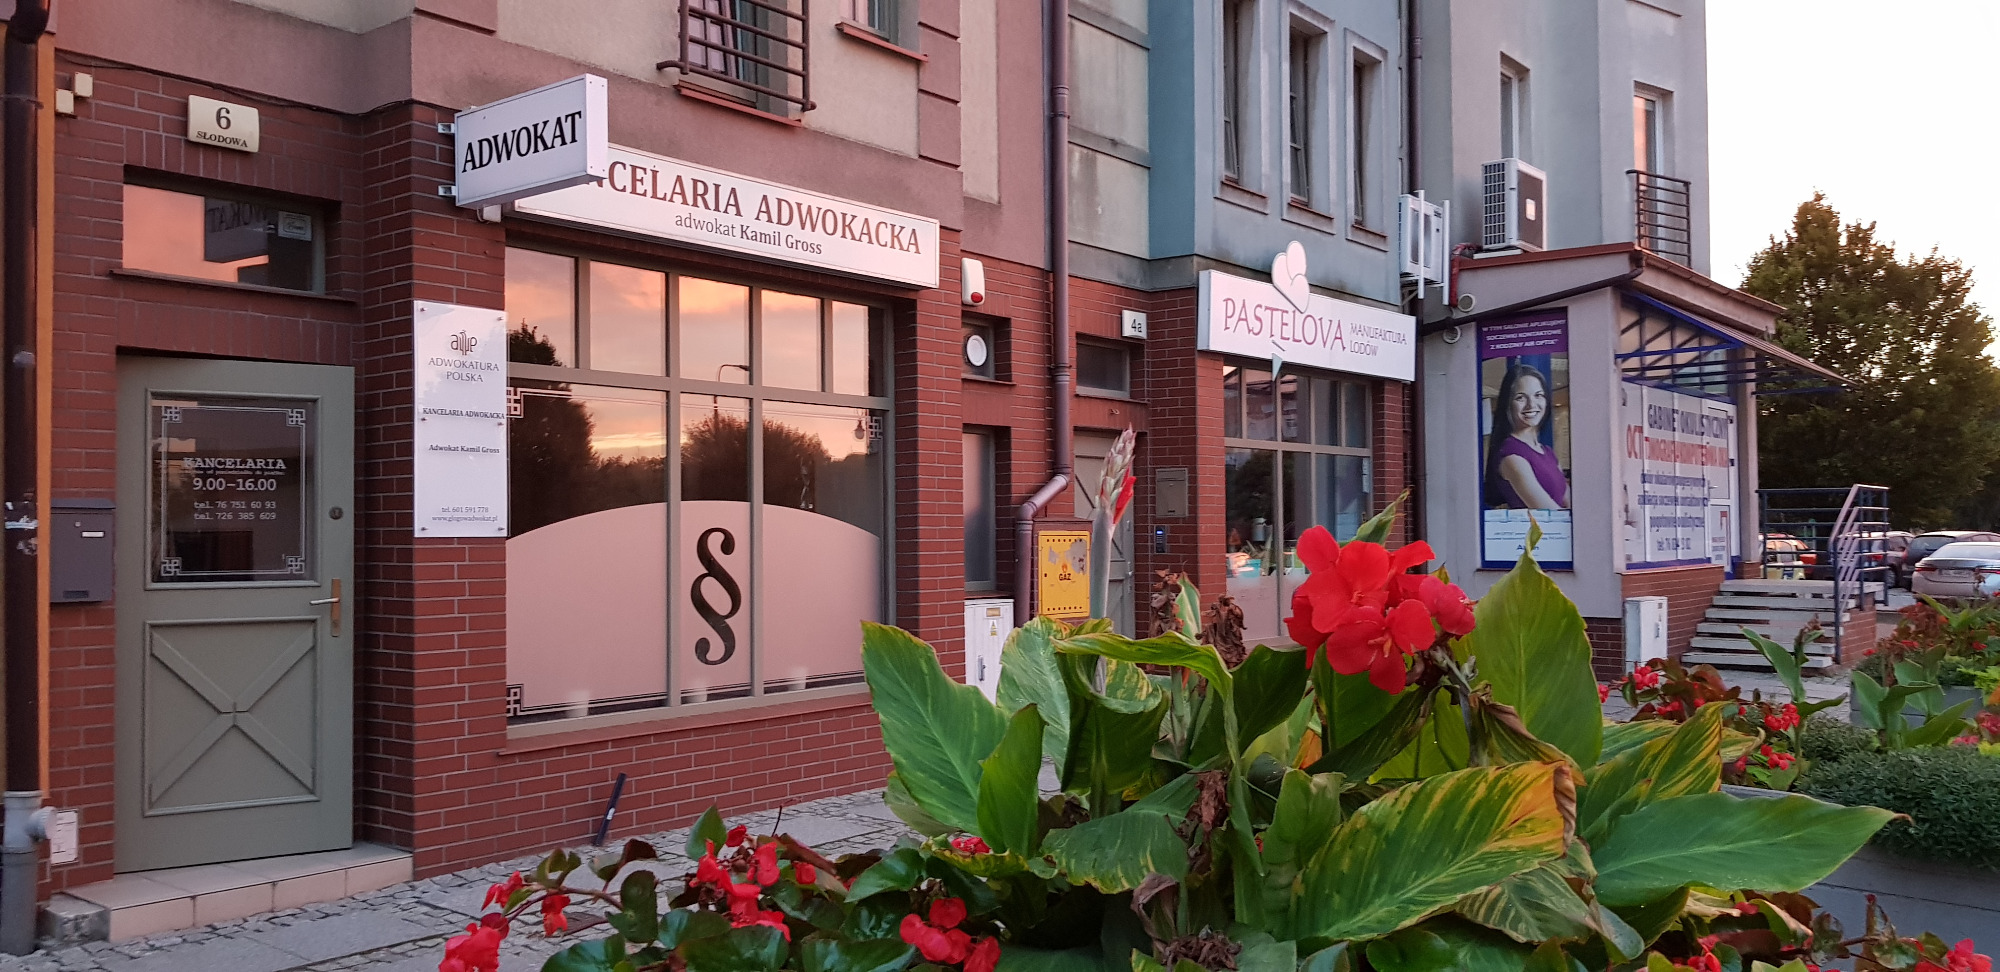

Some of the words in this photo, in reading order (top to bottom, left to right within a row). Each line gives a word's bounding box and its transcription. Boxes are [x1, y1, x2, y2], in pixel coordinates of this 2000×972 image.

[216, 107, 231, 130] 6
[196, 131, 249, 148] SŁODOWA
[461, 110, 582, 174] ADWOKAT
[586, 160, 743, 218] CELARIA
[755, 194, 922, 255] ADWOKACKA
[675, 213, 737, 238] adwokat
[740, 224, 781, 247] Kamil
[785, 234, 822, 255] Gross
[1131, 318, 1142, 333] 4a
[1223, 297, 1347, 351] PASTELOVA
[1350, 322, 1407, 345] MANUFAKTURA
[1350, 340, 1379, 357] LODÓW
[428, 357, 500, 372] ADWOKATURA
[446, 371, 484, 382] POLSKA
[422, 407, 464, 417] KANCELARIA
[464, 410, 505, 420] ADWOKACKA
[429, 444, 459, 452] Adwokat
[460, 445, 481, 453] Kamil
[183, 457, 287, 469] KANCELARIA
[192, 478, 277, 491] 9.00-16.00
[193, 501, 213, 509] tel.
[216, 501, 227, 509] 76
[231, 501, 246, 509] 751
[250, 501, 261, 509] 60
[265, 501, 276, 509] 93
[1058, 573, 1072, 581] GAZ
